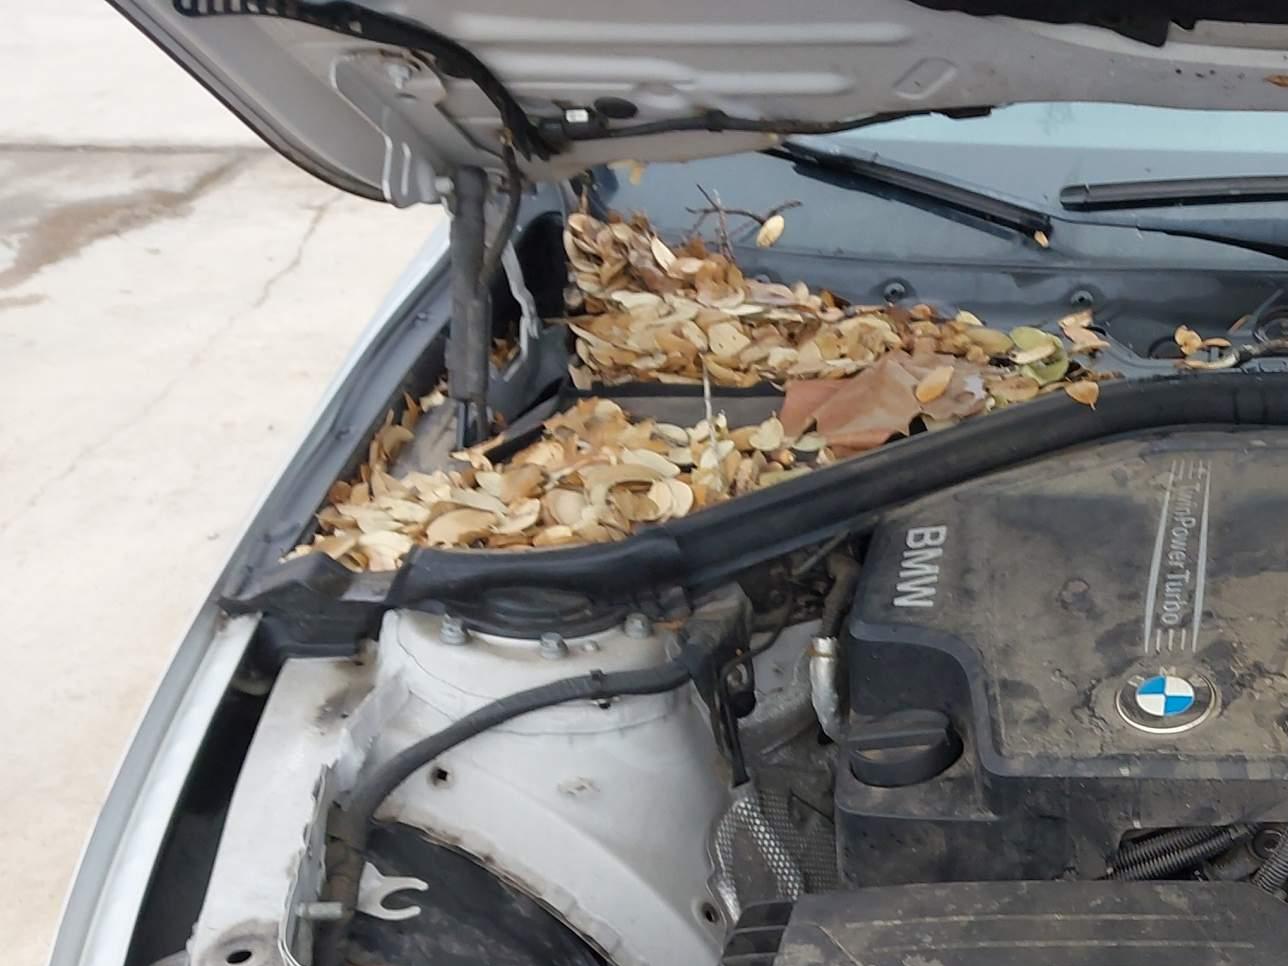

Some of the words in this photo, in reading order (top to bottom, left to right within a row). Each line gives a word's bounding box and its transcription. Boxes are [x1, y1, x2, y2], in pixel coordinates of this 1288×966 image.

[893, 525, 947, 607] BMW
[1168, 482, 1200, 568] TwinPower
[1161, 570, 1191, 625] Turbo
